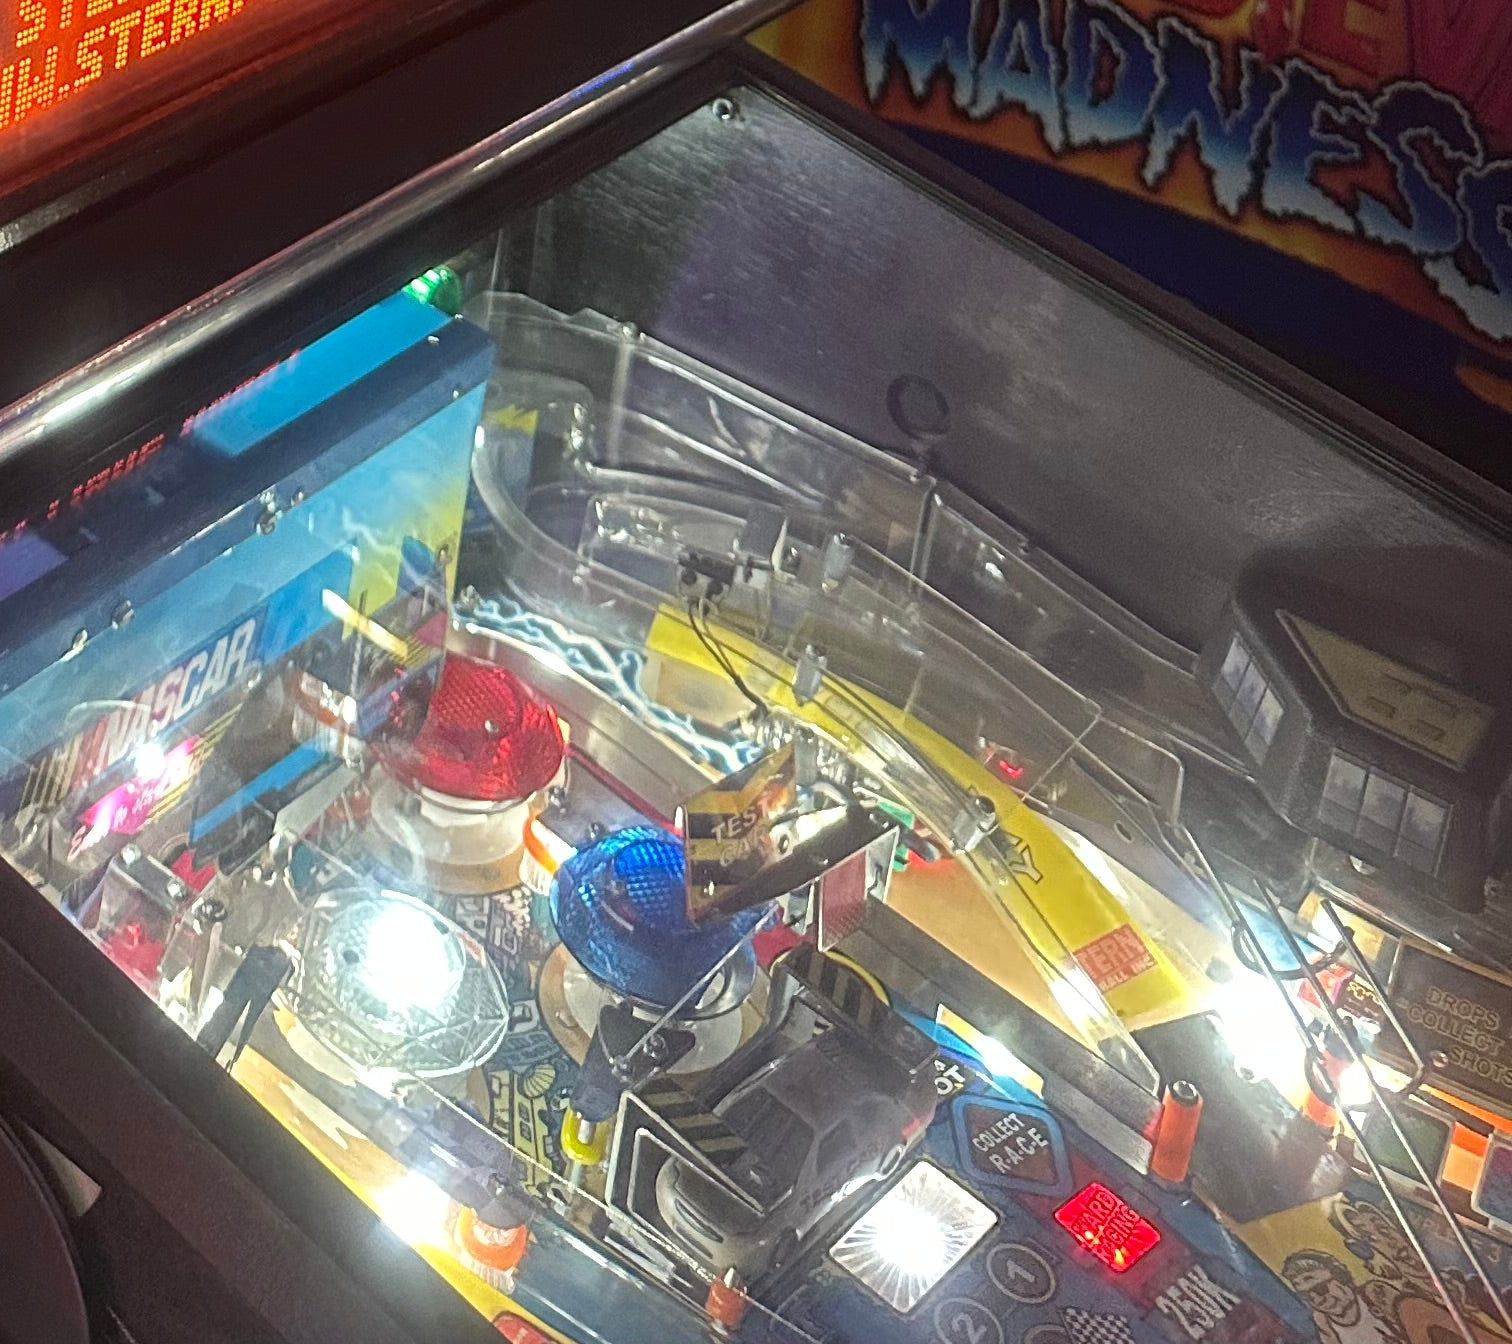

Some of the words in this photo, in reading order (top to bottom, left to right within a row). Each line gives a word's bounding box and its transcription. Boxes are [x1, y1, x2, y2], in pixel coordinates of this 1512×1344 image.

[105, 617, 256, 765] NASCAR
[710, 797, 771, 845] TEST
[1407, 1002, 1507, 1057] COLLECT
[1425, 986, 1502, 1031] DROPS
[1448, 1044, 1512, 1088] SHOTS
[971, 1111, 1026, 1153] COLLECT
[1007, 1259, 1036, 1284] 1
[1155, 1263, 1241, 1342] 250K
[951, 1310, 985, 1341] 2
